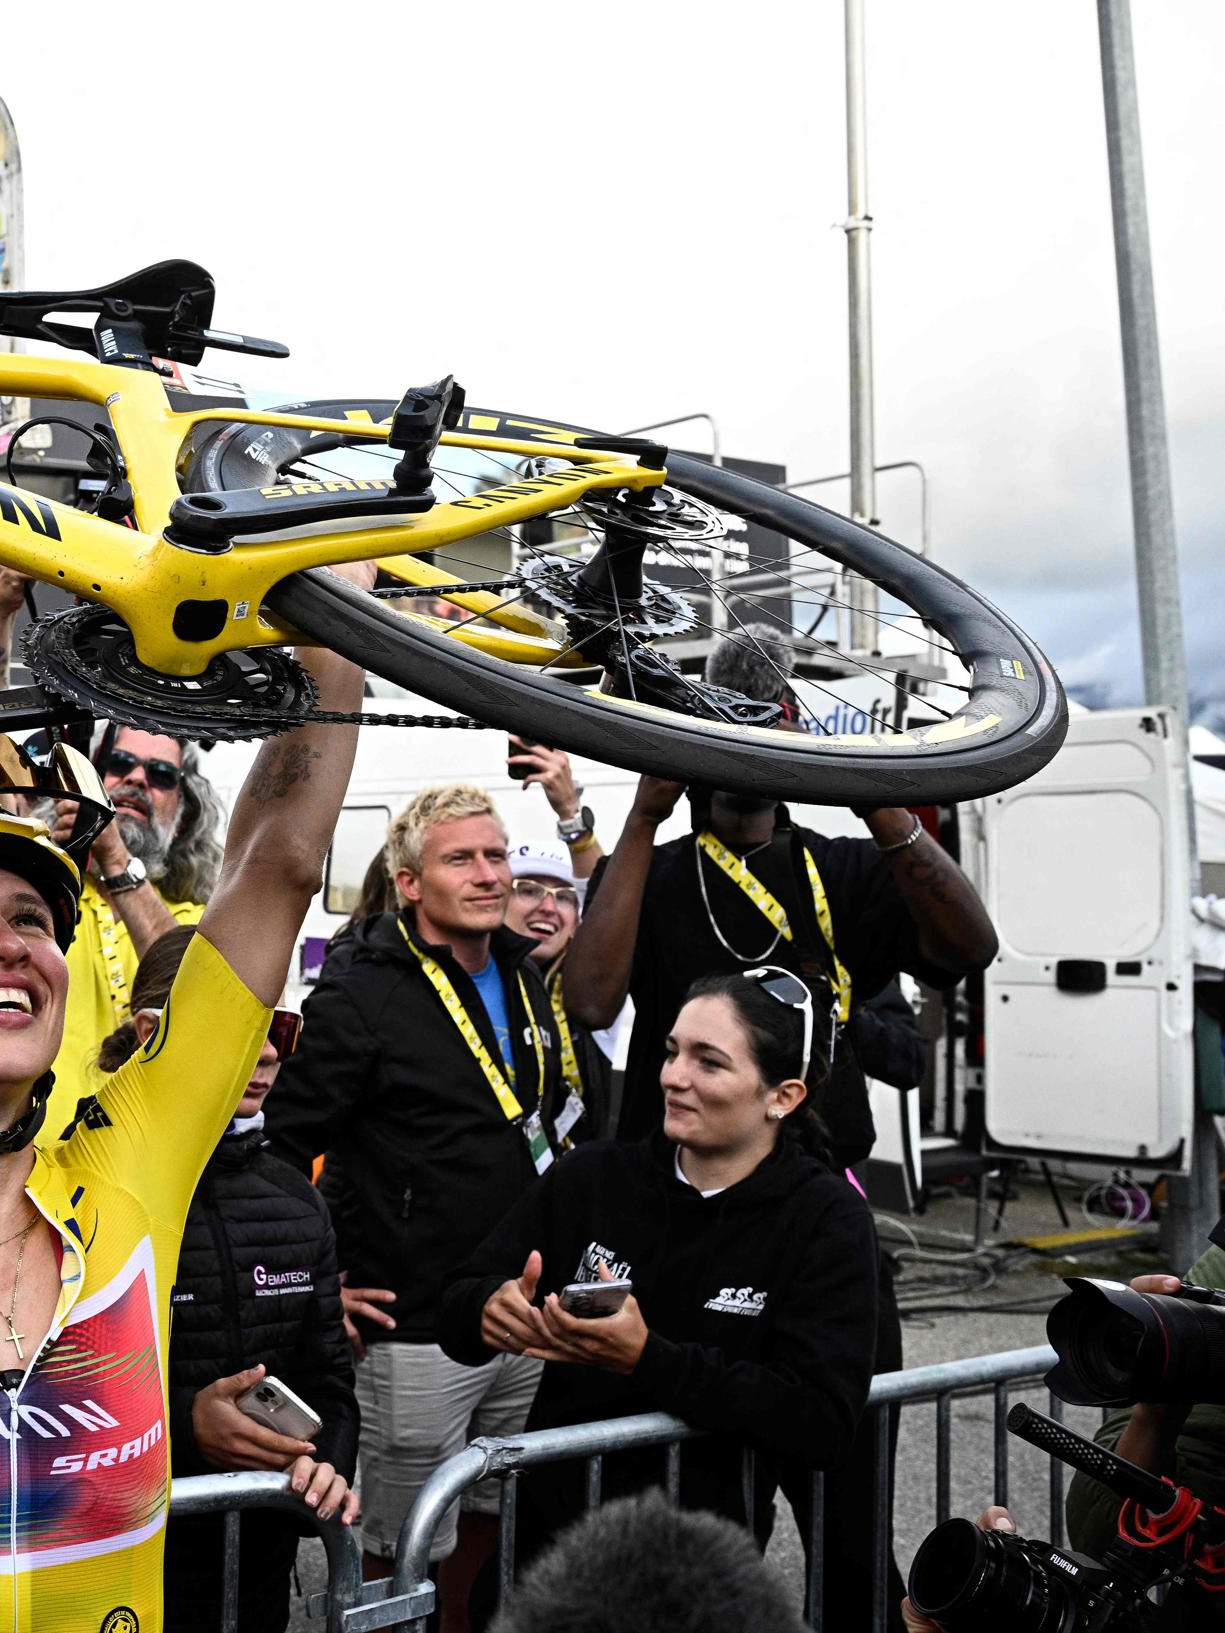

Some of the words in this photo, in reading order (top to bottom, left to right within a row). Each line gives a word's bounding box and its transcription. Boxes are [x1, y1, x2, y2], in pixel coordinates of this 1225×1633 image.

[99, 328, 119, 357] CANYON
[244, 431, 274, 460] ZIPP
[259, 479, 397, 500] SRAM
[449, 464, 614, 511] CANYON
[254, 1265, 310, 1286] GEMATECH
[49, 1419, 162, 1476] SRAM
[1050, 1553, 1079, 1577] FUJIFILM
